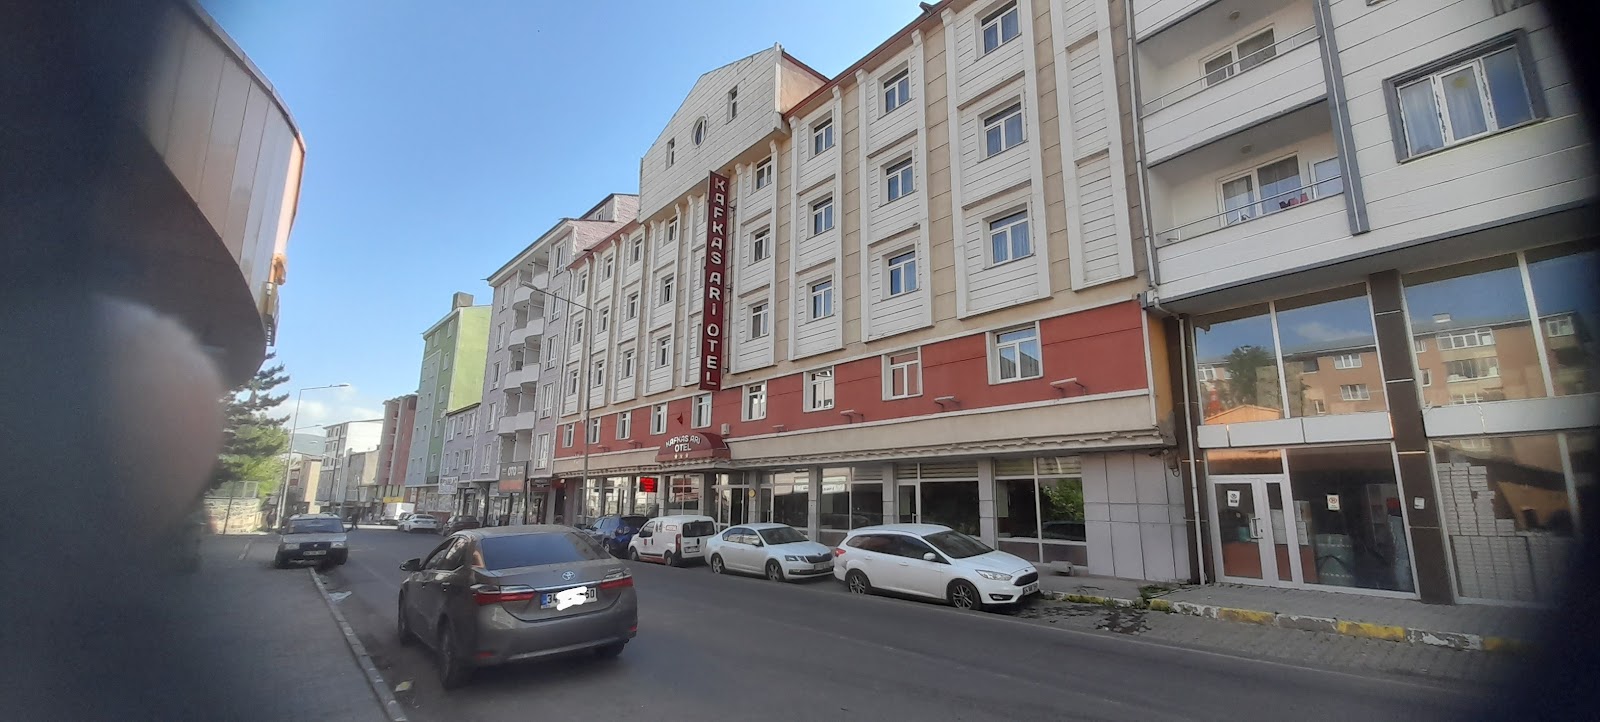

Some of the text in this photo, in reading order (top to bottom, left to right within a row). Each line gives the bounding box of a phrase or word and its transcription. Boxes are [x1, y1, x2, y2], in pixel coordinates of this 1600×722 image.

[711, 177, 726, 265] KAFKAS
[705, 323, 721, 386] OTEL
[674, 443, 692, 453] OTEL
[547, 593, 558, 604] 34
